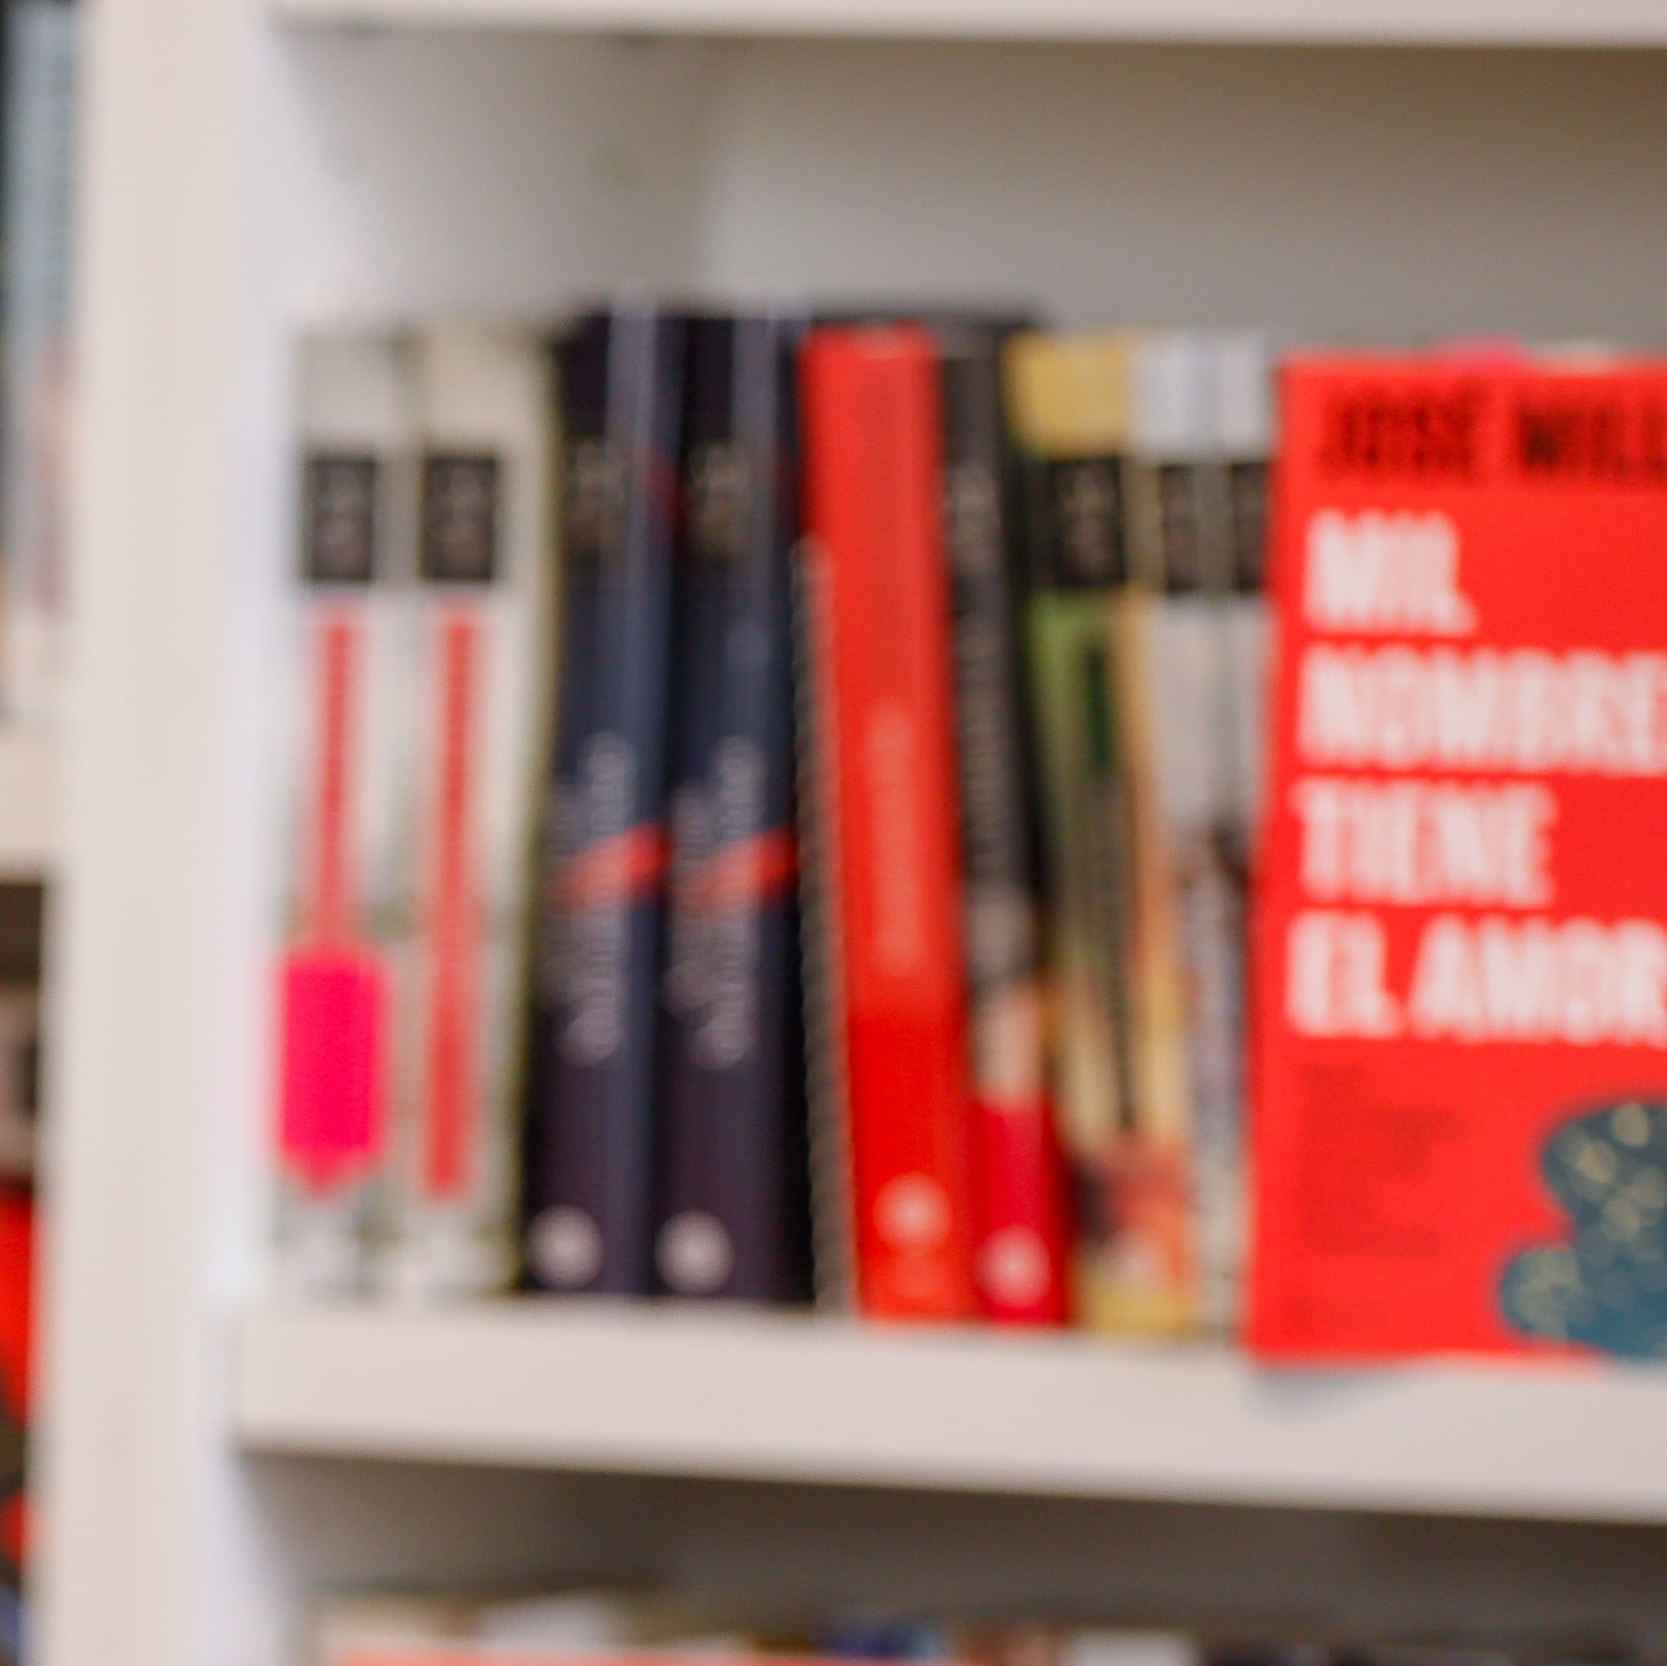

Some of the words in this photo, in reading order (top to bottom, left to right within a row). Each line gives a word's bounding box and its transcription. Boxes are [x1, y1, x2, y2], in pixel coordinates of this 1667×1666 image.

[1305, 508, 1475, 637] MIL
[1294, 778, 1559, 911] TIENE
[1287, 910, 1402, 1040] EL
[1410, 914, 1667, 1048] AMOR
